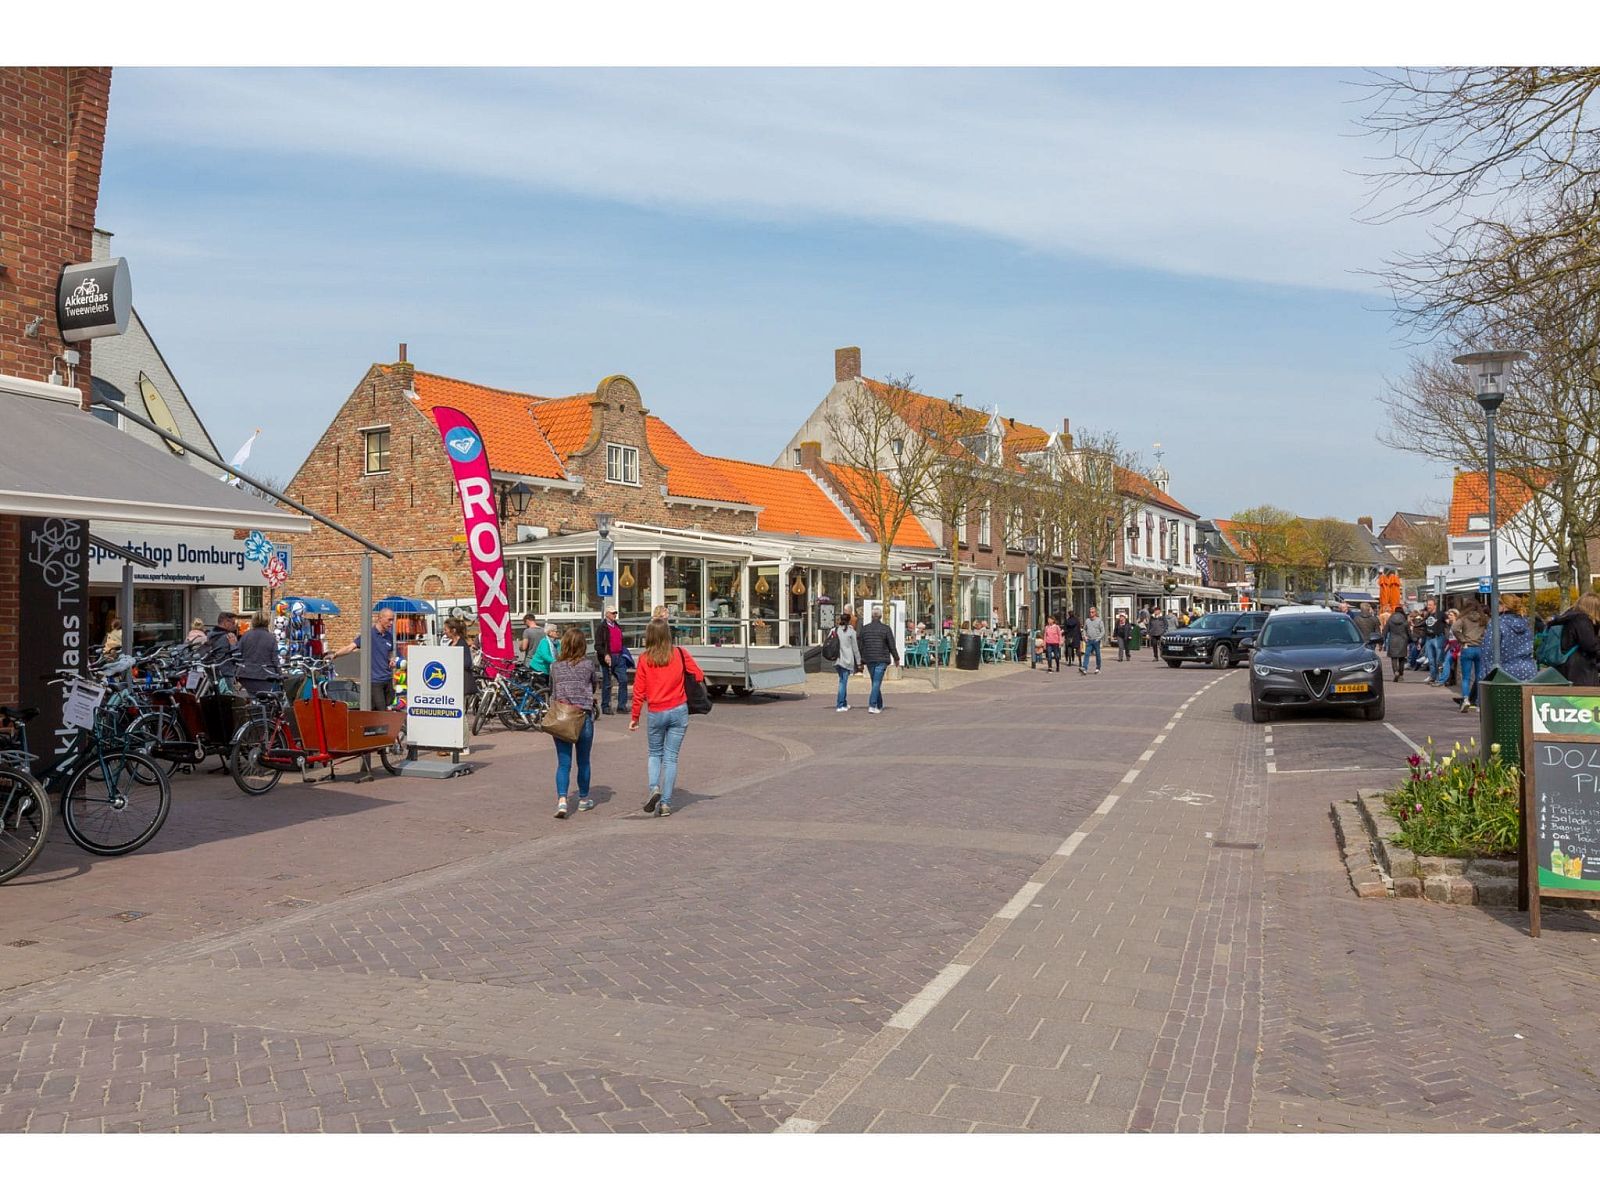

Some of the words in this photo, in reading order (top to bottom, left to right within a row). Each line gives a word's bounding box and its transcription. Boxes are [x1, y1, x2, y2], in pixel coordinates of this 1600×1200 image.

[65, 293, 108, 306] Akkerdaas
[65, 303, 109, 317] Tweewielers
[177, 543, 245, 571] Domburg
[458, 476, 511, 650] ROXY
[414, 695, 455, 706] Gazelle
[412, 708, 459, 717] VERHUURPUNT
